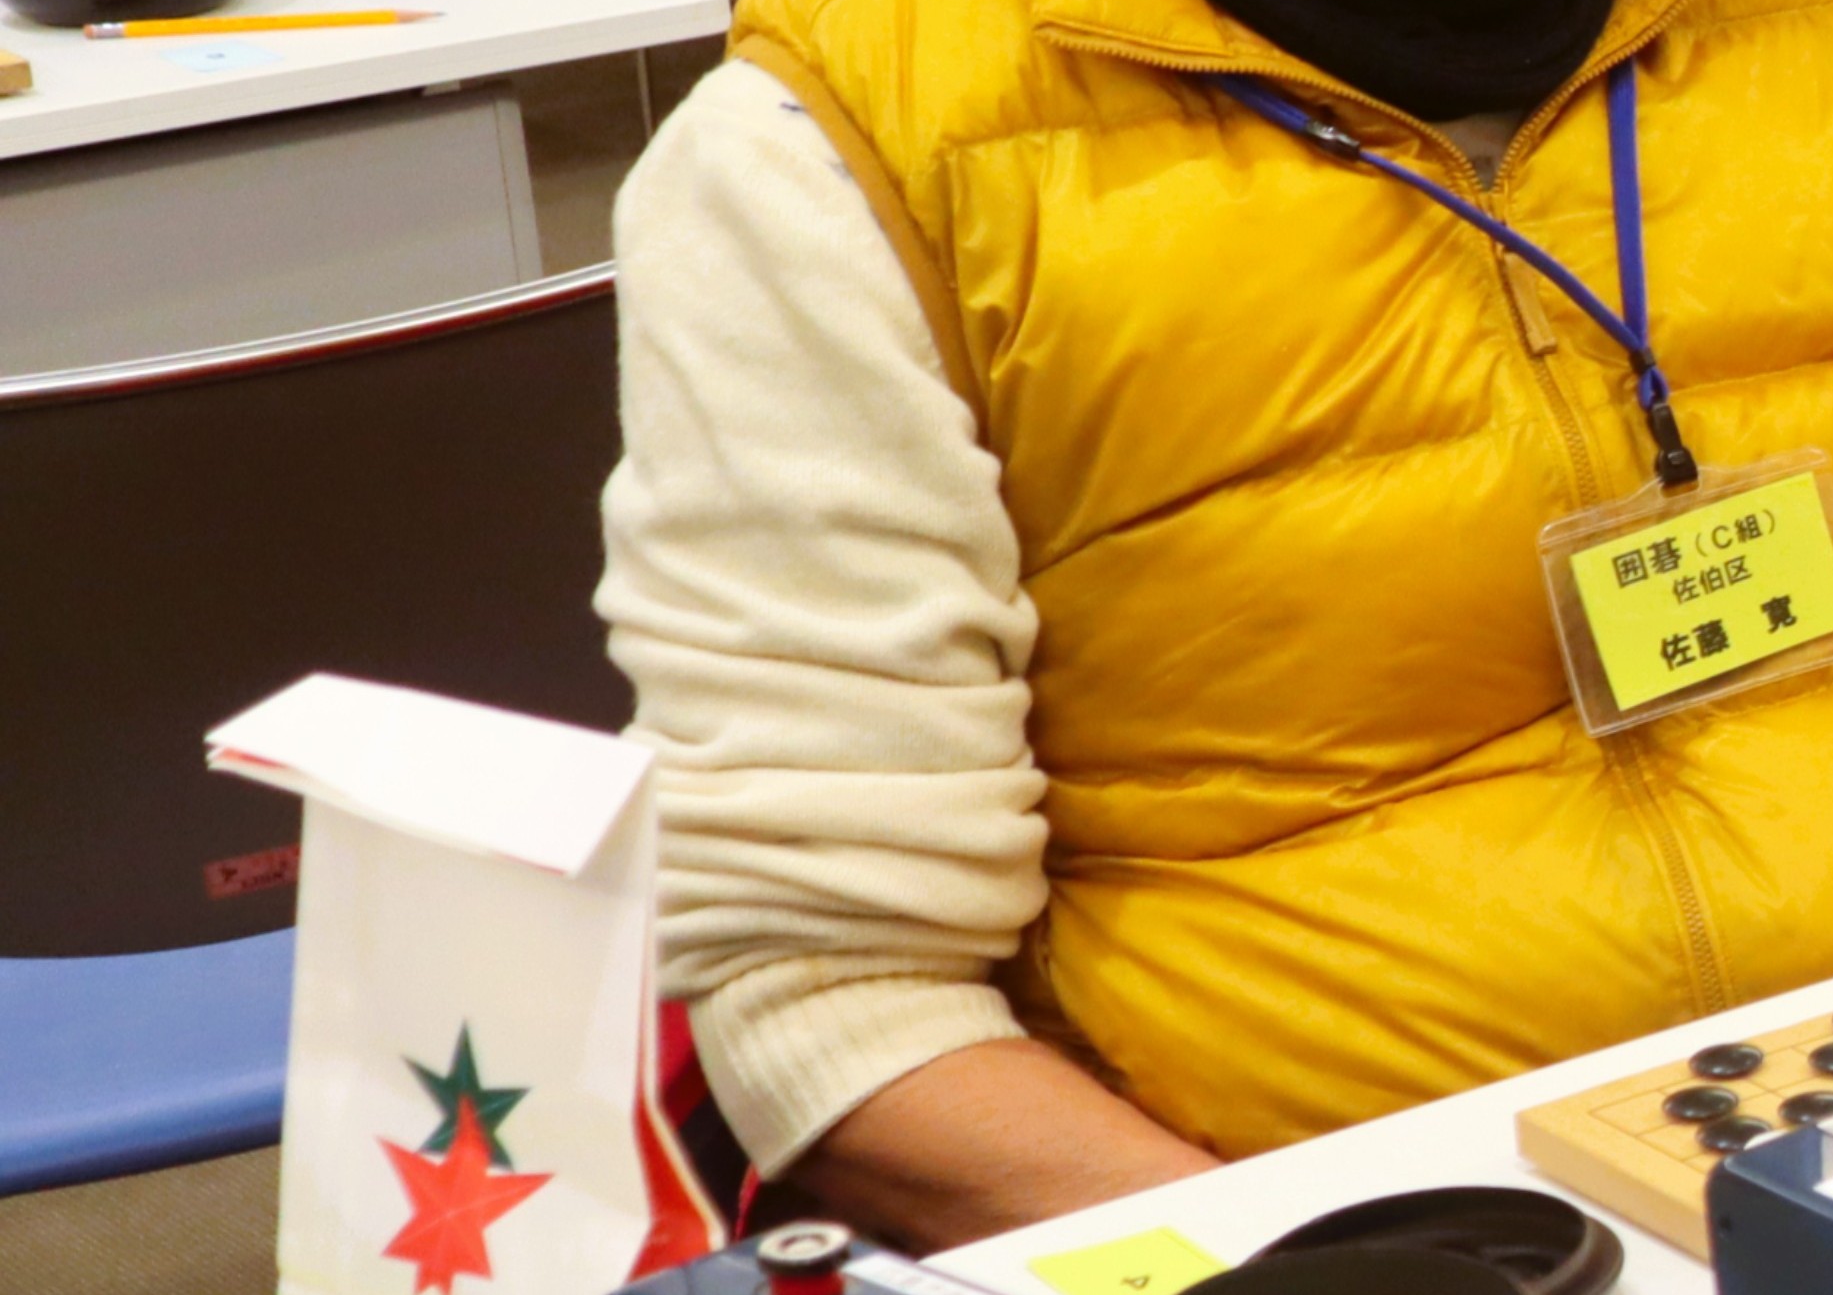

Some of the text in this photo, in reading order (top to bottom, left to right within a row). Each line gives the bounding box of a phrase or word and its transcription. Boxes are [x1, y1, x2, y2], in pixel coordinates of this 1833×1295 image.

[1671, 554, 1753, 605] 佐伯区
[1659, 618, 1732, 673] 佐藤
